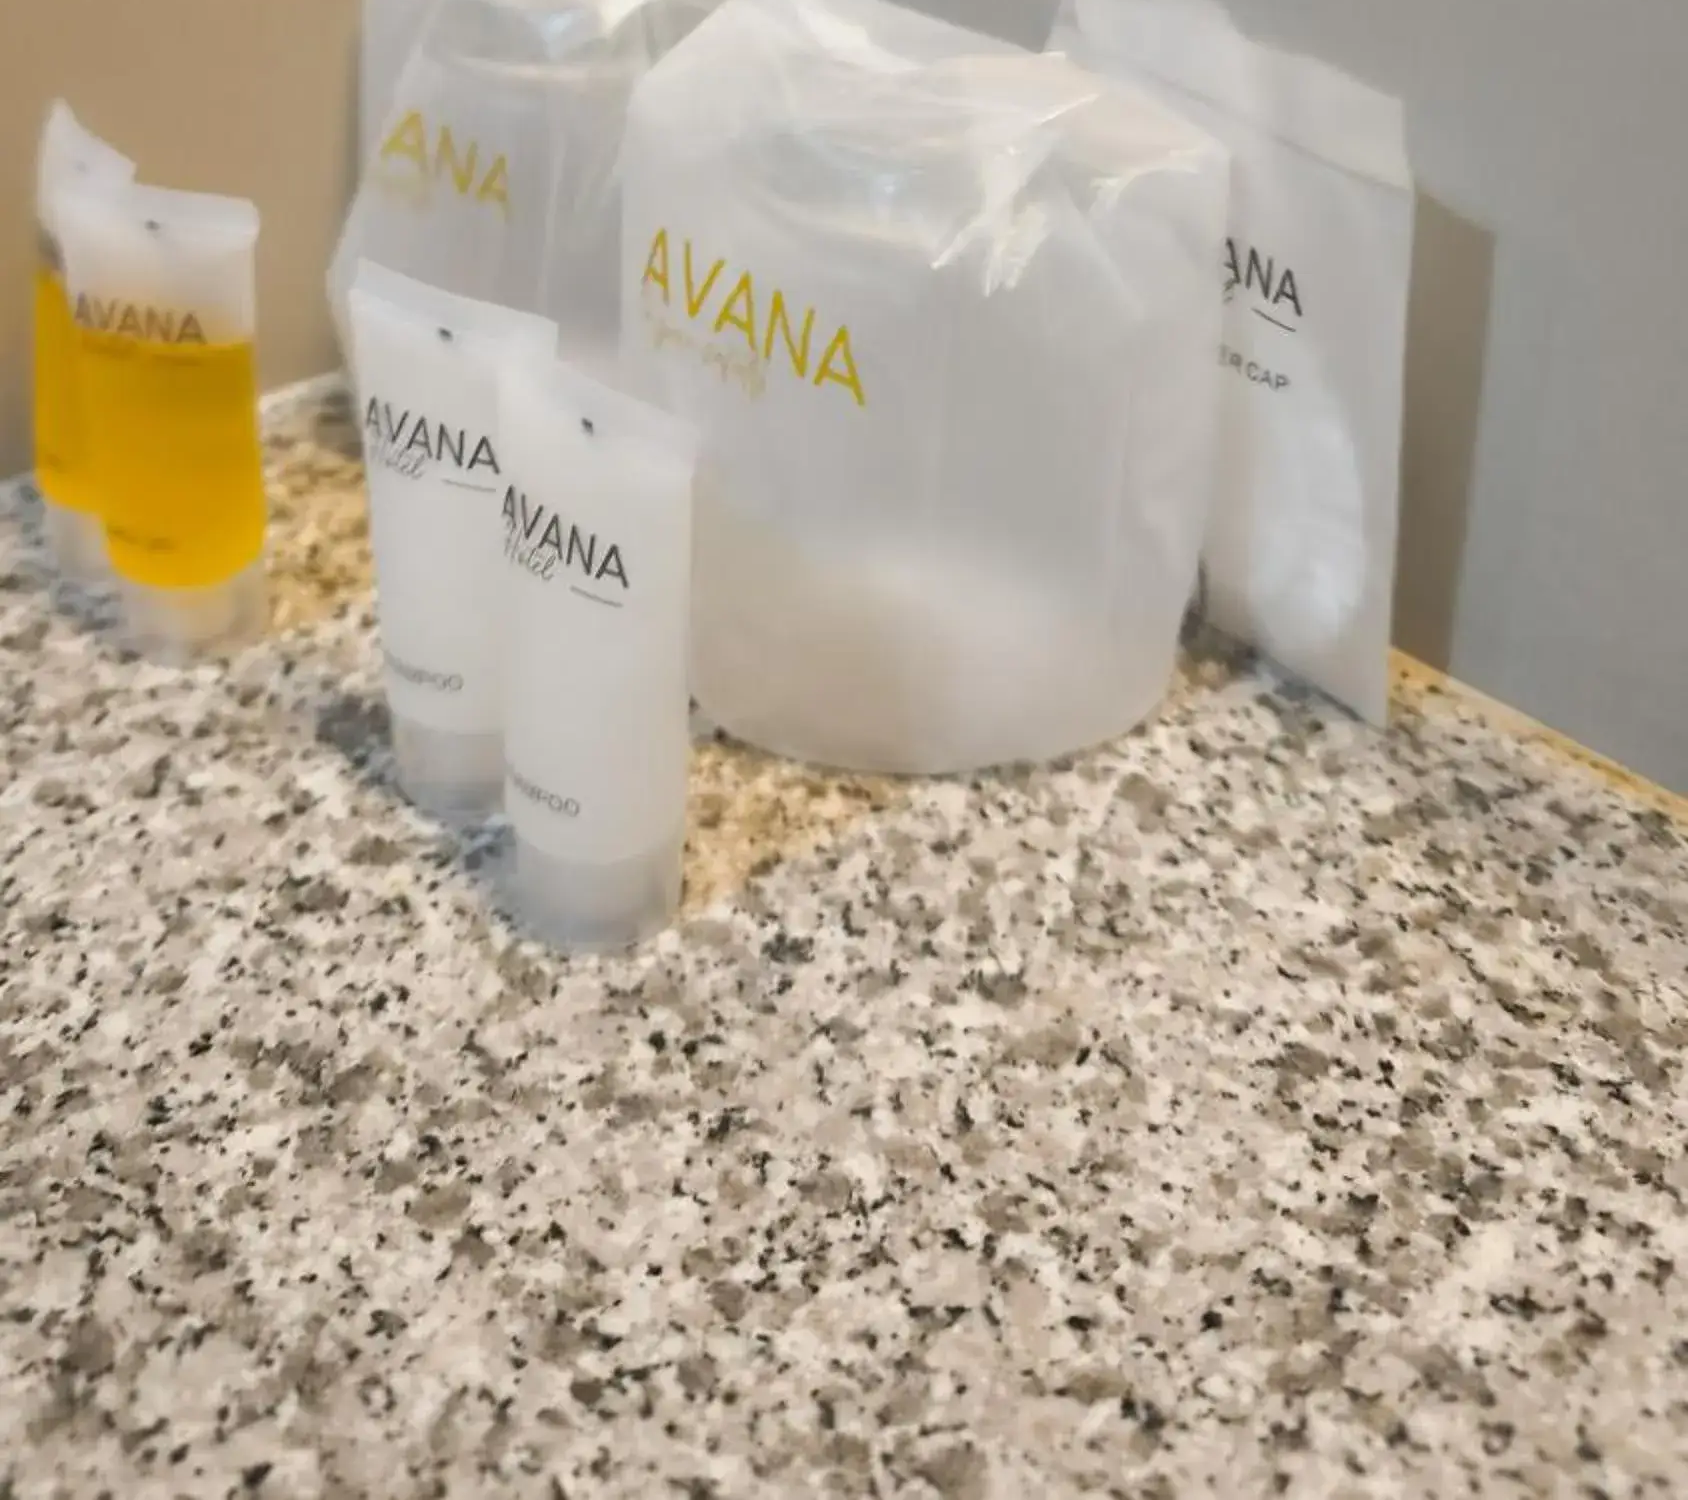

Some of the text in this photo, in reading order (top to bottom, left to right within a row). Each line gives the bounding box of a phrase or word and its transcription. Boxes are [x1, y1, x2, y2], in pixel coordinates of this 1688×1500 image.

[75, 292, 208, 346] AVANA
[642, 226, 867, 408] AVANA
[1246, 361, 1291, 392] CAP
[365, 396, 501, 476] AVANA
[502, 483, 630, 589] AVANA
